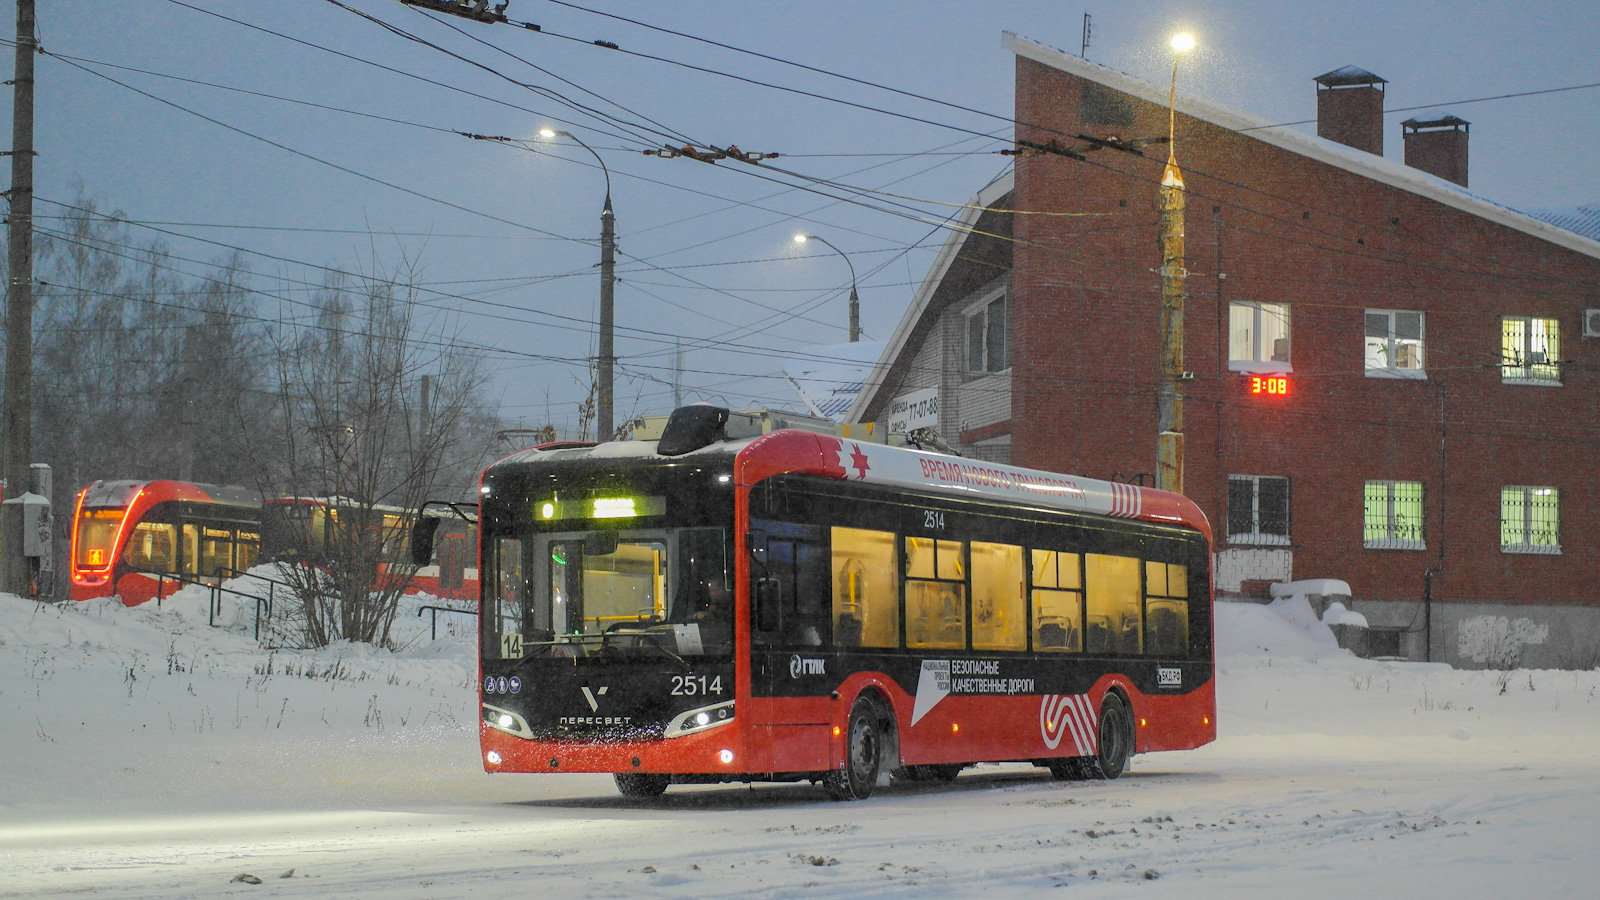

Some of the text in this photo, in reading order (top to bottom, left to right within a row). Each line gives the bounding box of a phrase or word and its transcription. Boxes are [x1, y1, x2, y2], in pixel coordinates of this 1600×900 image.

[1252, 378, 1286, 394] 3:08
[909, 397, 937, 421] 77-07-88
[919, 458, 963, 482] ВРЕМЯ
[963, 465, 1010, 490] НОВОГО
[924, 510, 945, 529] 2514
[504, 635, 520, 658] 14
[802, 659, 825, 674] ГТЛК
[952, 660, 999, 674] БЕЗОПАСНЫЕ
[671, 675, 723, 695] 2514
[952, 679, 1034, 695] КАЧЕСТВЕННЫЕ ДОРОГИ
[560, 717, 631, 725] ПЕРЕСВЕТ
